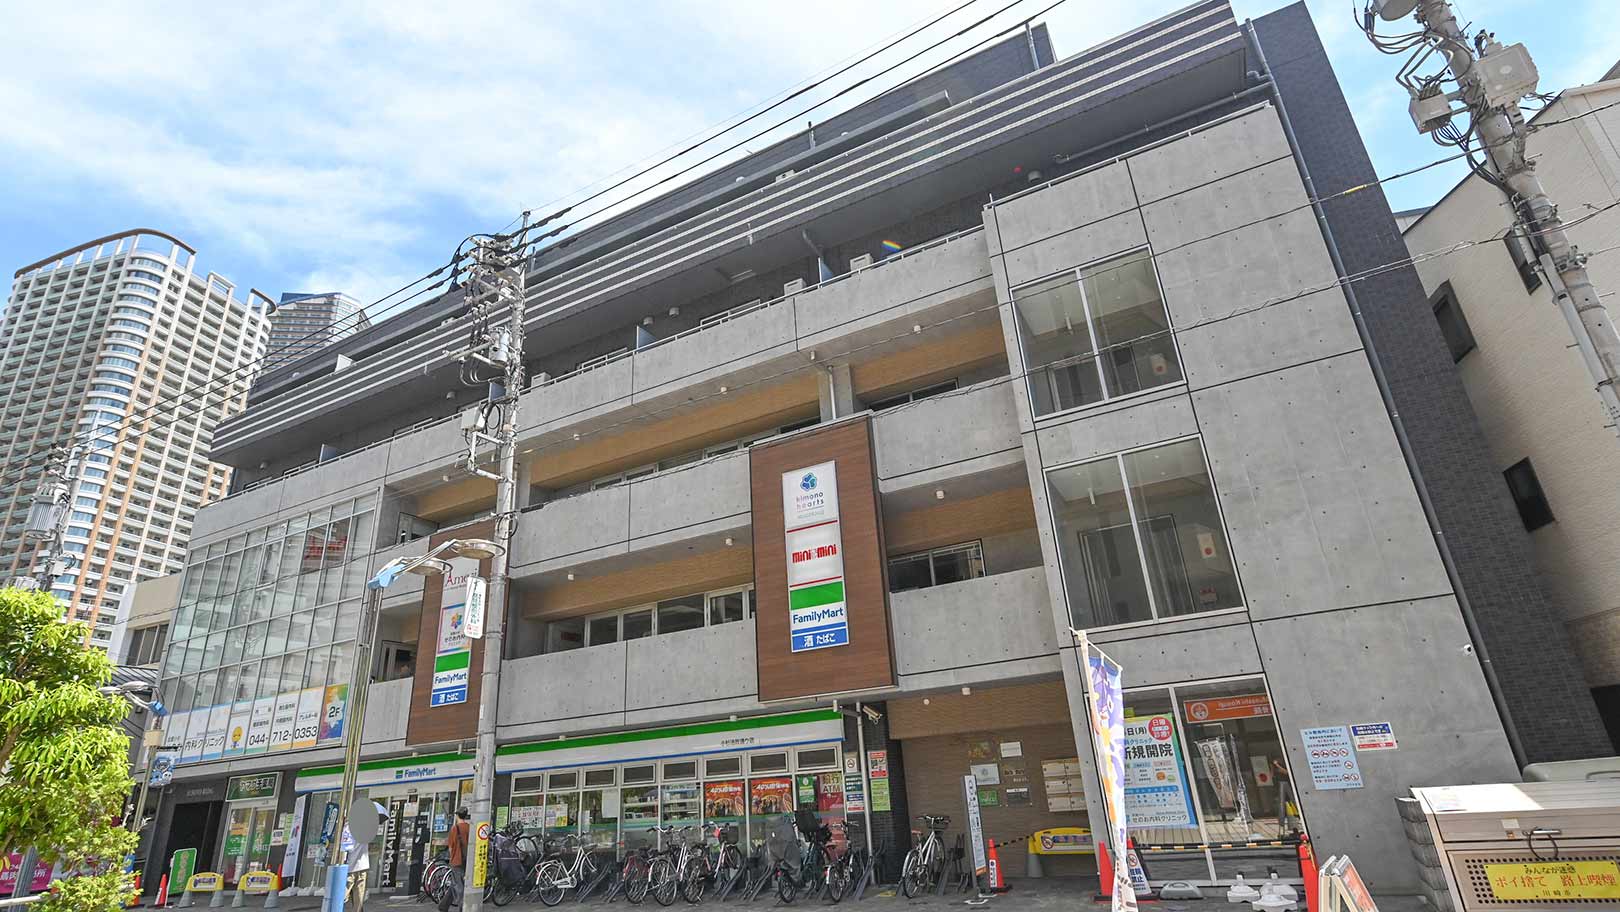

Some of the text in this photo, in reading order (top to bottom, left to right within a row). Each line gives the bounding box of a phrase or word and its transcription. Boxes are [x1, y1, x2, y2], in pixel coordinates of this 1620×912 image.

[796, 491, 824, 503] kimono
[792, 544, 837, 564] mini mini
[792, 606, 844, 625] FamilyMart
[804, 632, 836, 647] 酒 たばこ
[434, 672, 467, 685] FamilyMart
[328, 706, 341, 718] 2F
[1124, 726, 1147, 737] 日(月)
[404, 768, 437, 778] FamilyMart
[823, 785, 841, 793] ATM
[382, 801, 402, 887] FamilyMart
[1525, 866, 1576, 874] みんなが迷惑
[1496, 874, 1617, 888] ポイ捨て 路上喫煙
